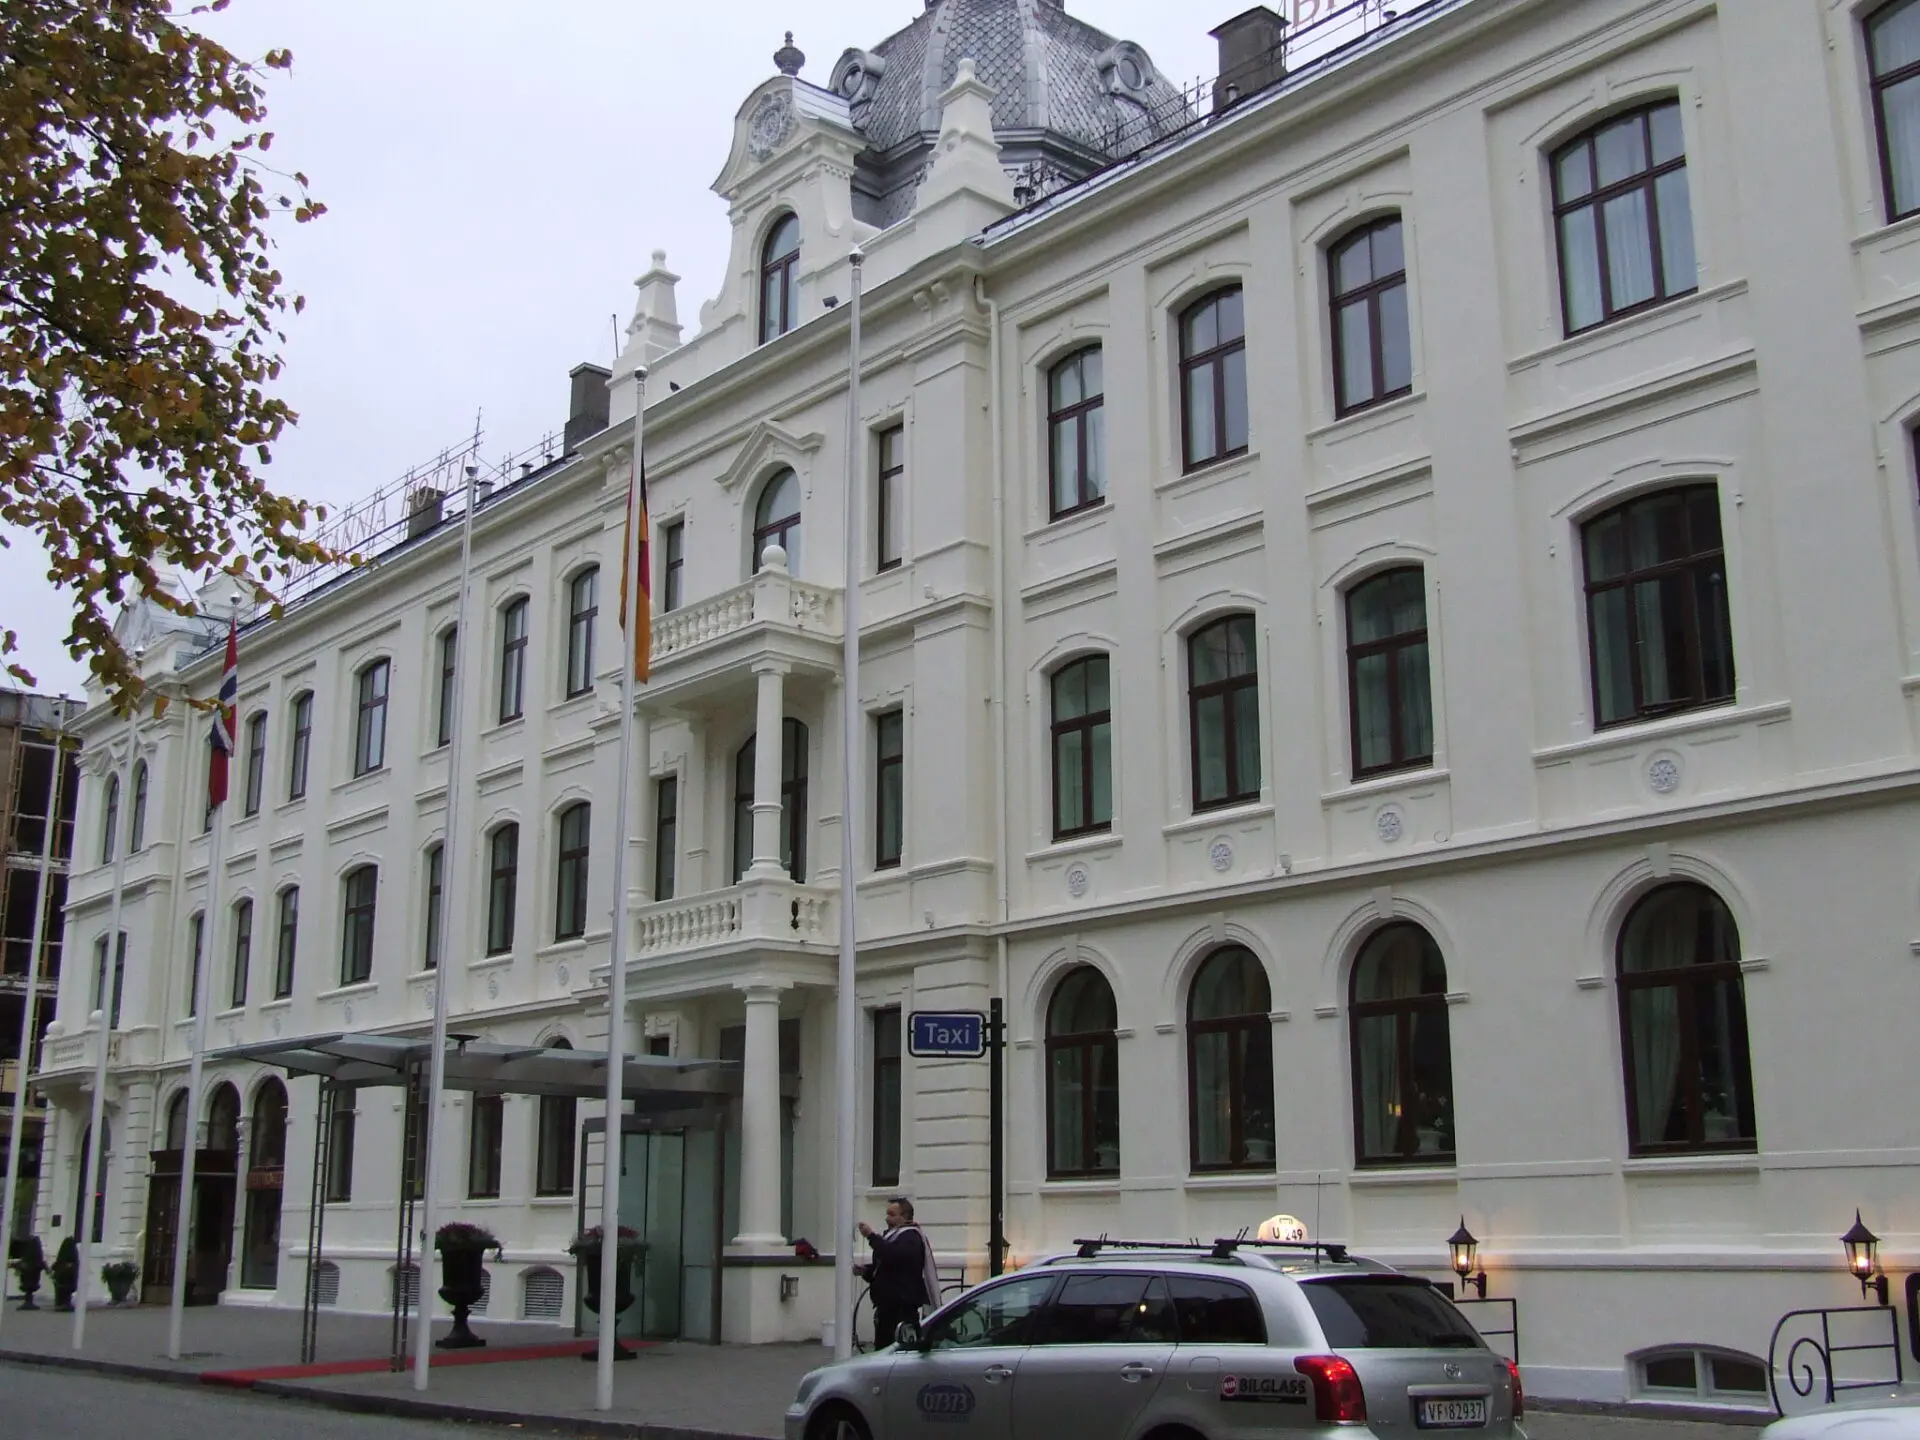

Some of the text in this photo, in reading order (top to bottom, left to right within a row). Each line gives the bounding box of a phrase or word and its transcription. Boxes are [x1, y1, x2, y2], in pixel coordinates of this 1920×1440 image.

[400, 455, 468, 517] HOTEL
[924, 1022, 970, 1044] Taxi
[1272, 1226, 1303, 1241] U 249
[1239, 1378, 1306, 1394] BILGLASS
[923, 1392, 967, 1411] 07373
[1428, 1402, 1482, 1420] VF 82937
